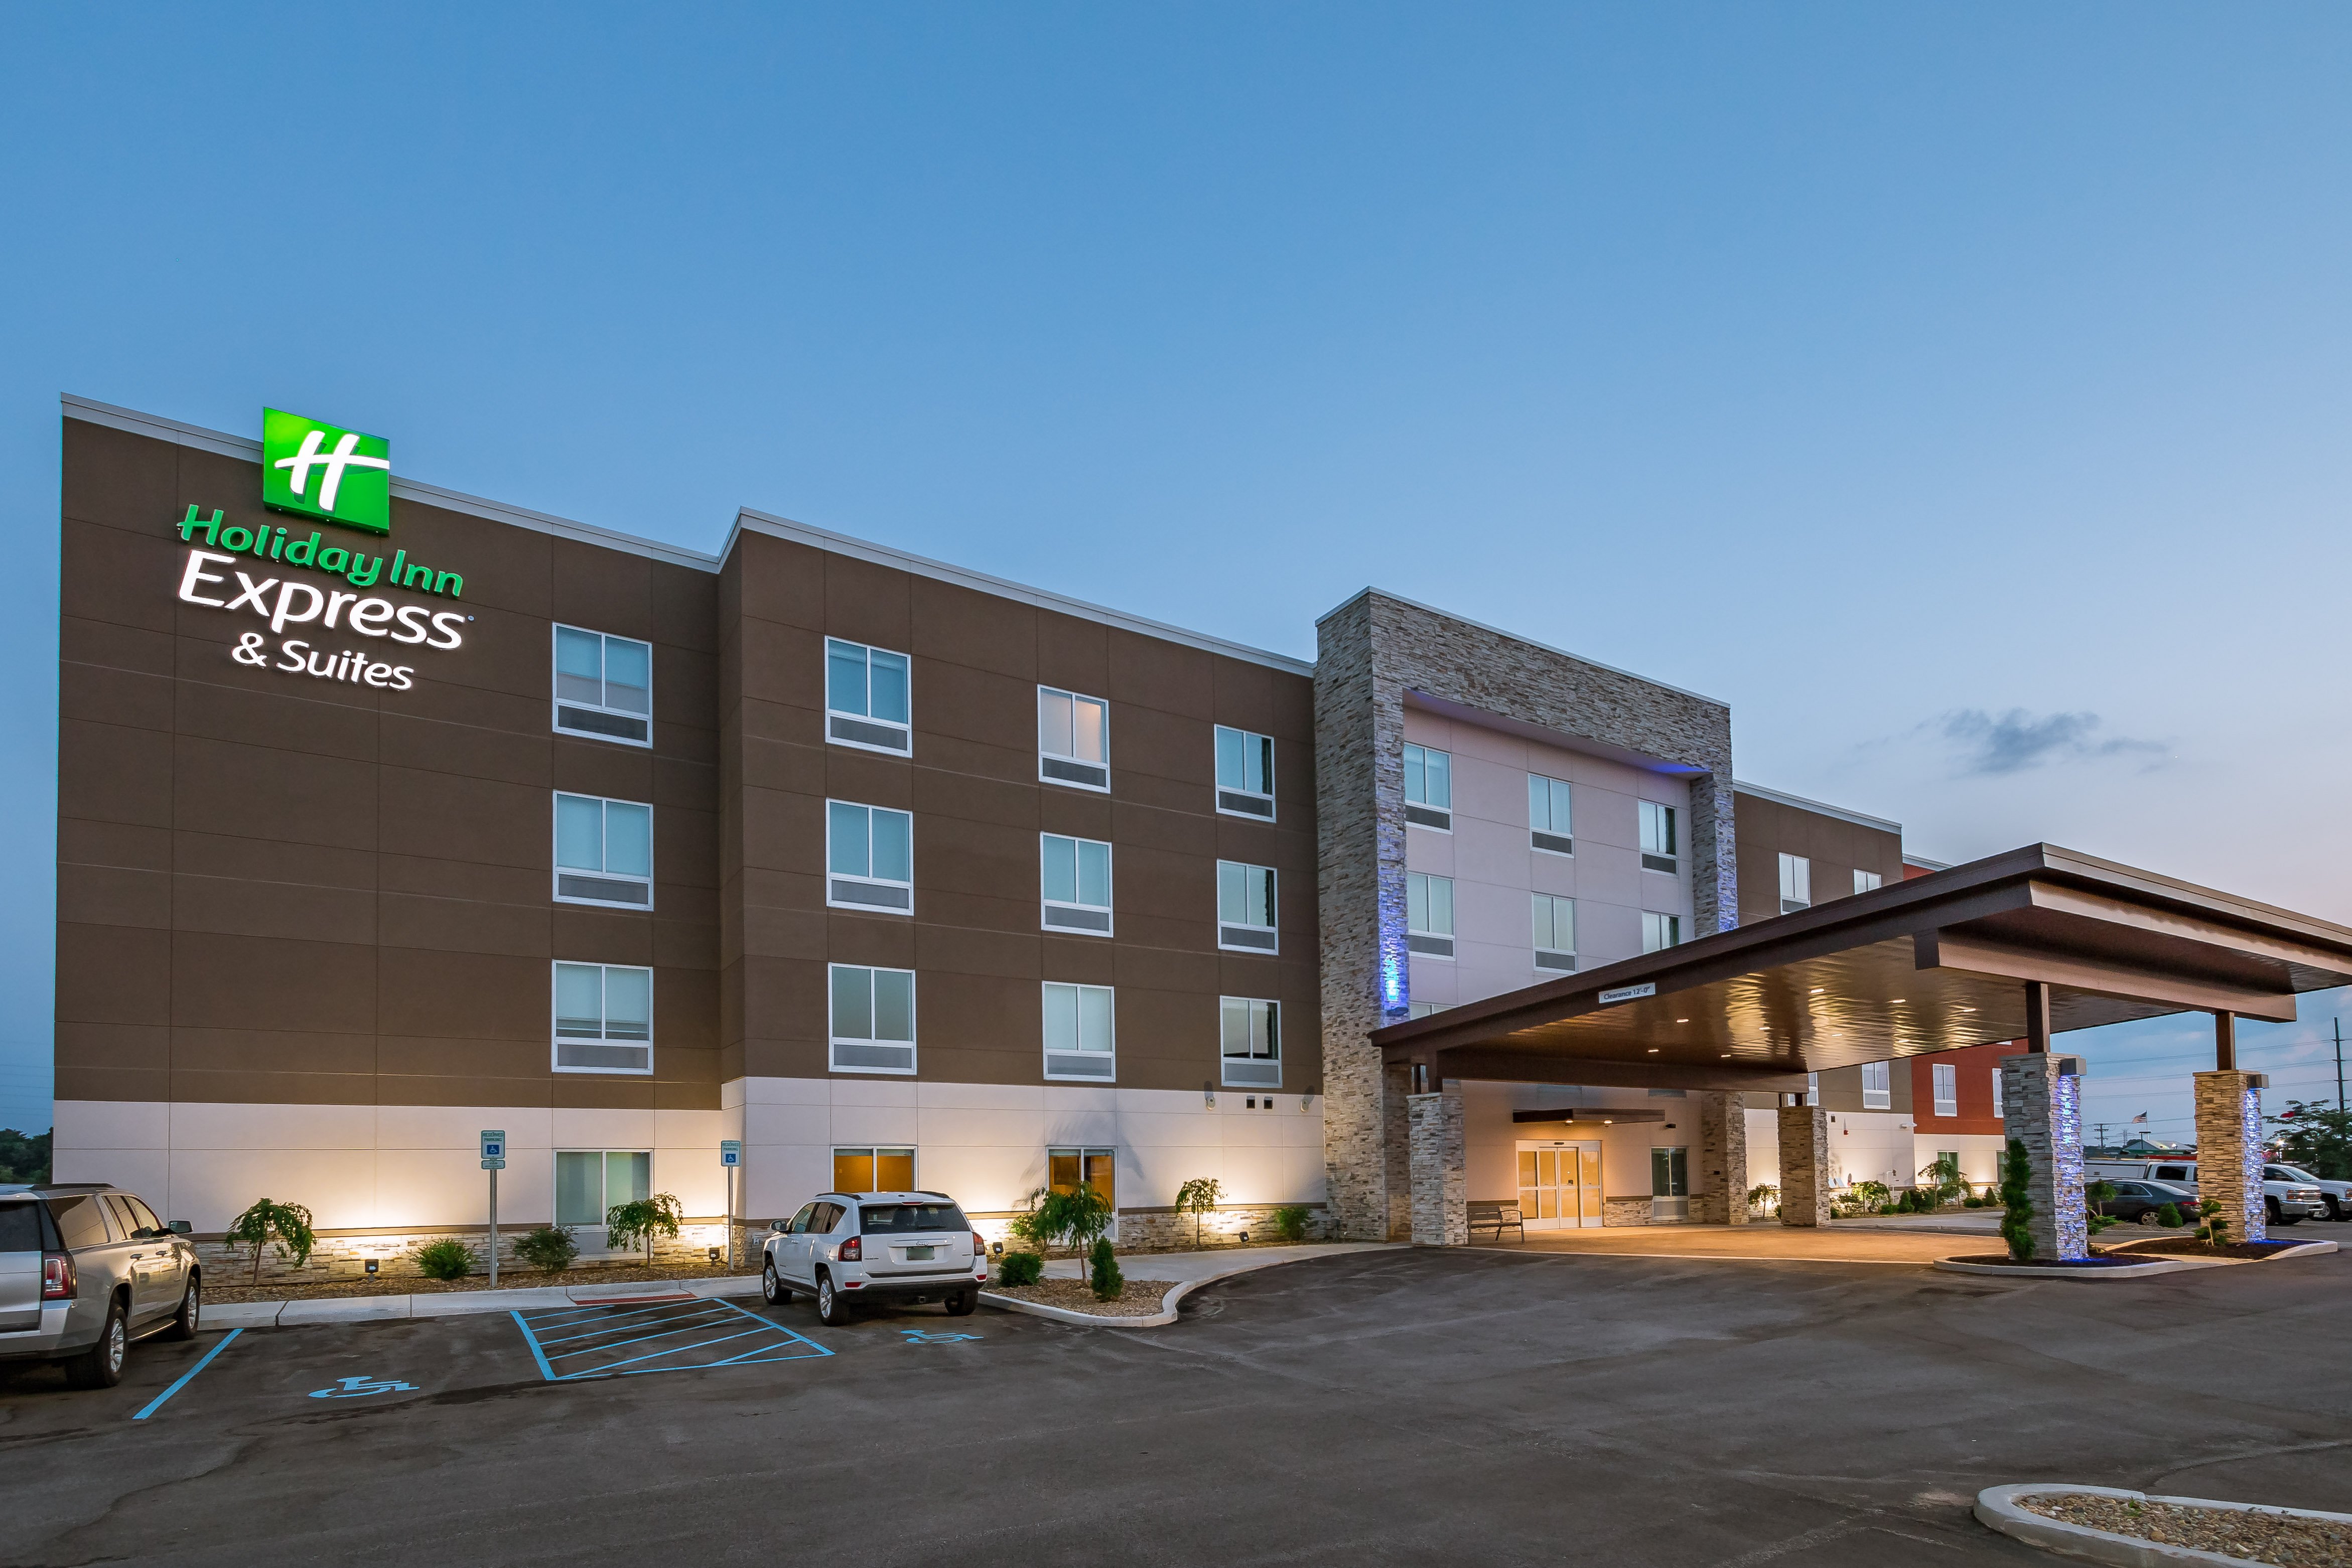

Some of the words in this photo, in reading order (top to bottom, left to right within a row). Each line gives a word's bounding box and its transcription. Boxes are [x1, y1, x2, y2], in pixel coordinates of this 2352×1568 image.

[177, 504, 382, 588] Holiday
[389, 549, 463, 597] Inn
[231, 632, 267, 668] &
[276, 640, 414, 690] Suites
[1604, 990, 1632, 1000] Clearance
